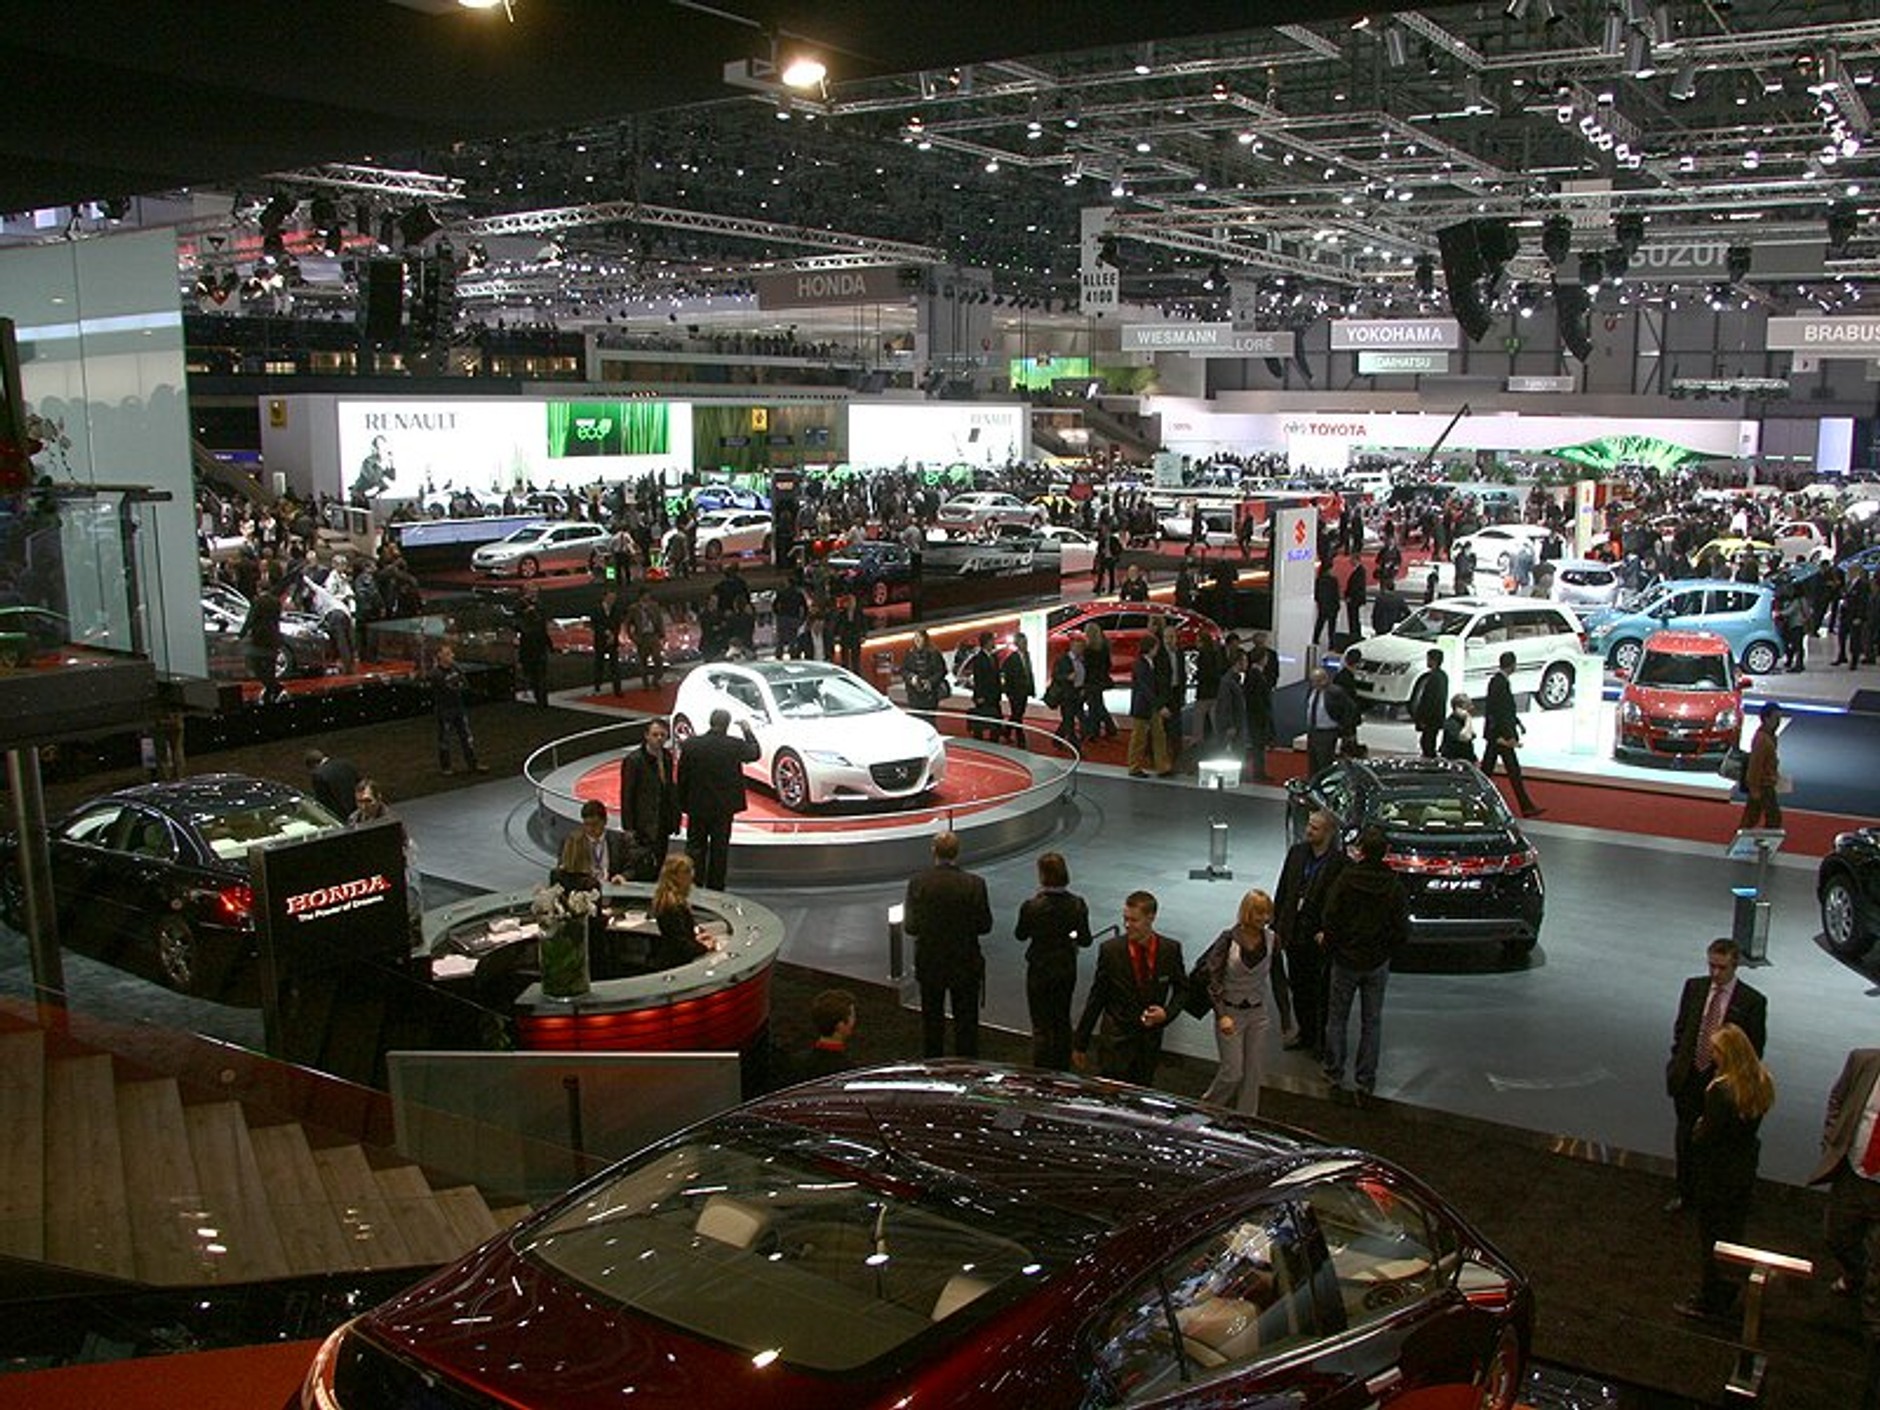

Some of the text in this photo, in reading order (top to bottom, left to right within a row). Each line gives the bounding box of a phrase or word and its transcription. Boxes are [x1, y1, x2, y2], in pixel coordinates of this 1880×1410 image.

[1628, 244, 1731, 267] SUZUK
[798, 274, 866, 297] HONDA
[1137, 329, 1217, 344] WIESMANN
[1346, 326, 1443, 341] YOKOHAMA
[1376, 357, 1431, 368] DAIHATSU
[365, 413, 458, 430] RENAULT
[1309, 422, 1367, 436] TOYOTA
[286, 874, 391, 914] HONDA
